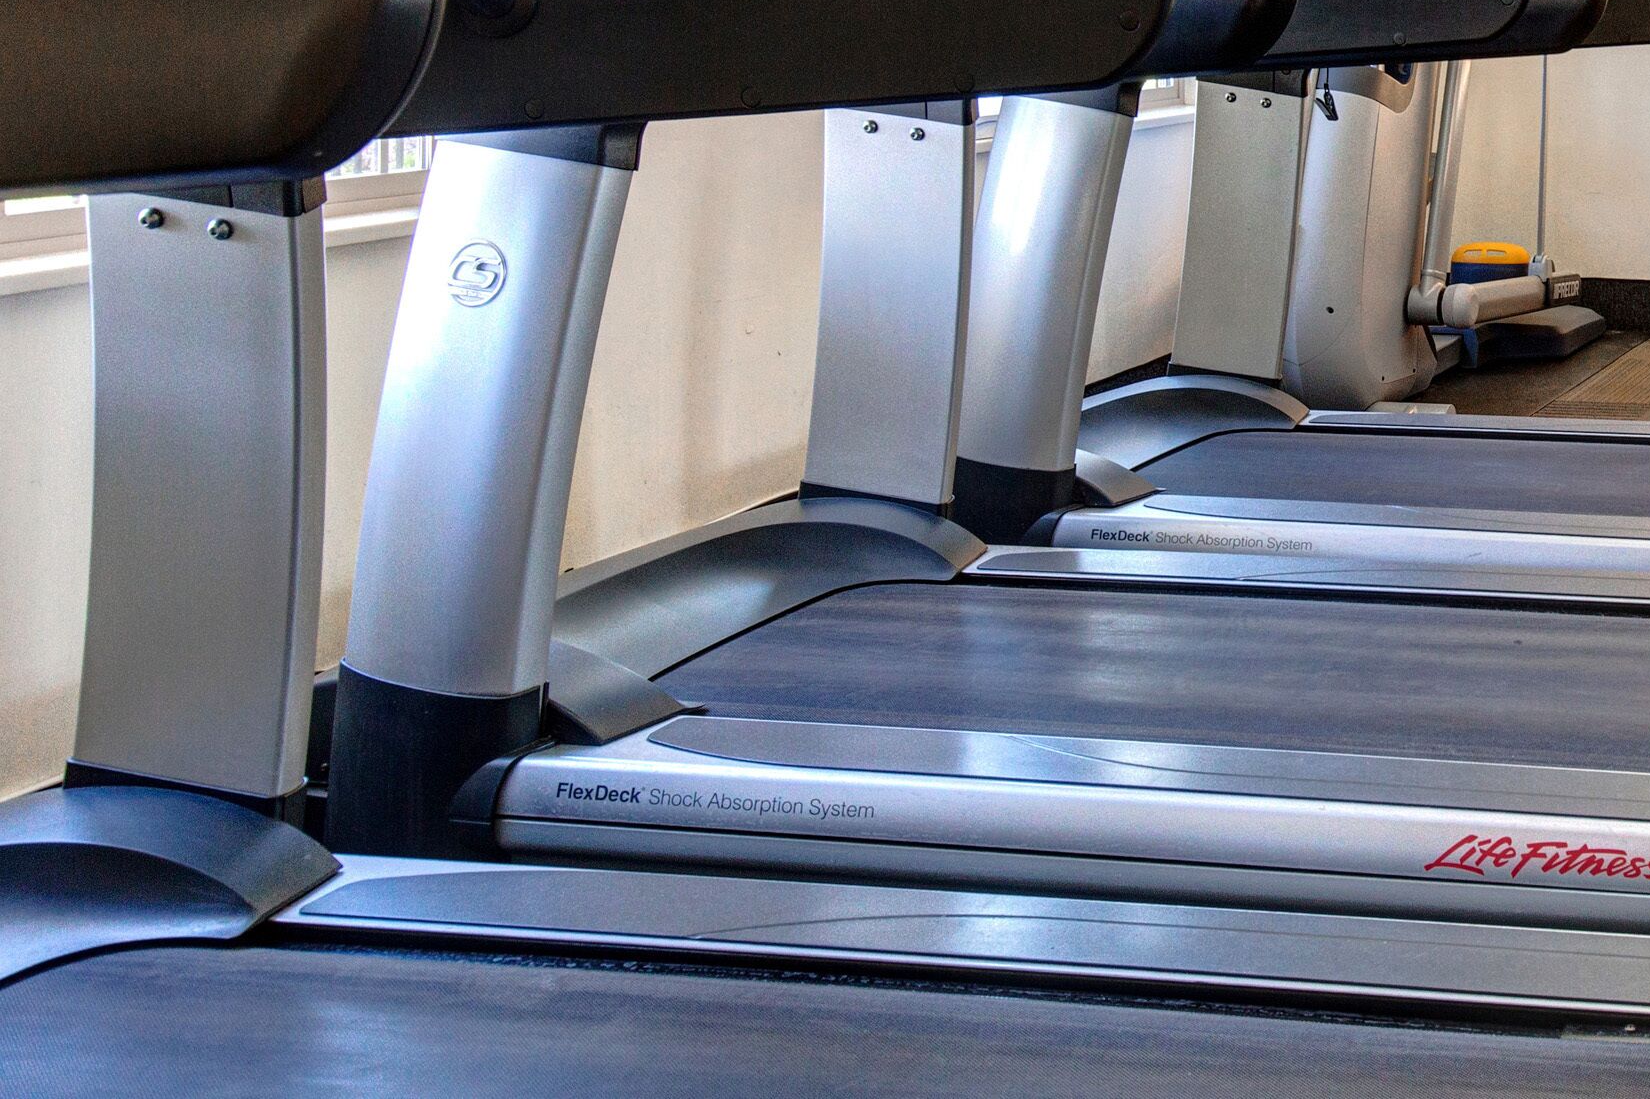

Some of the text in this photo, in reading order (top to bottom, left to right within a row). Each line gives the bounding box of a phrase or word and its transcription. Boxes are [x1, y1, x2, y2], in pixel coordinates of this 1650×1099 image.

[1091, 529, 1312, 552] FlexDeck Shock Absorption System
[557, 782, 874, 820] FlexDeck Shock Absorption System
[1424, 835, 1516, 876] Life
